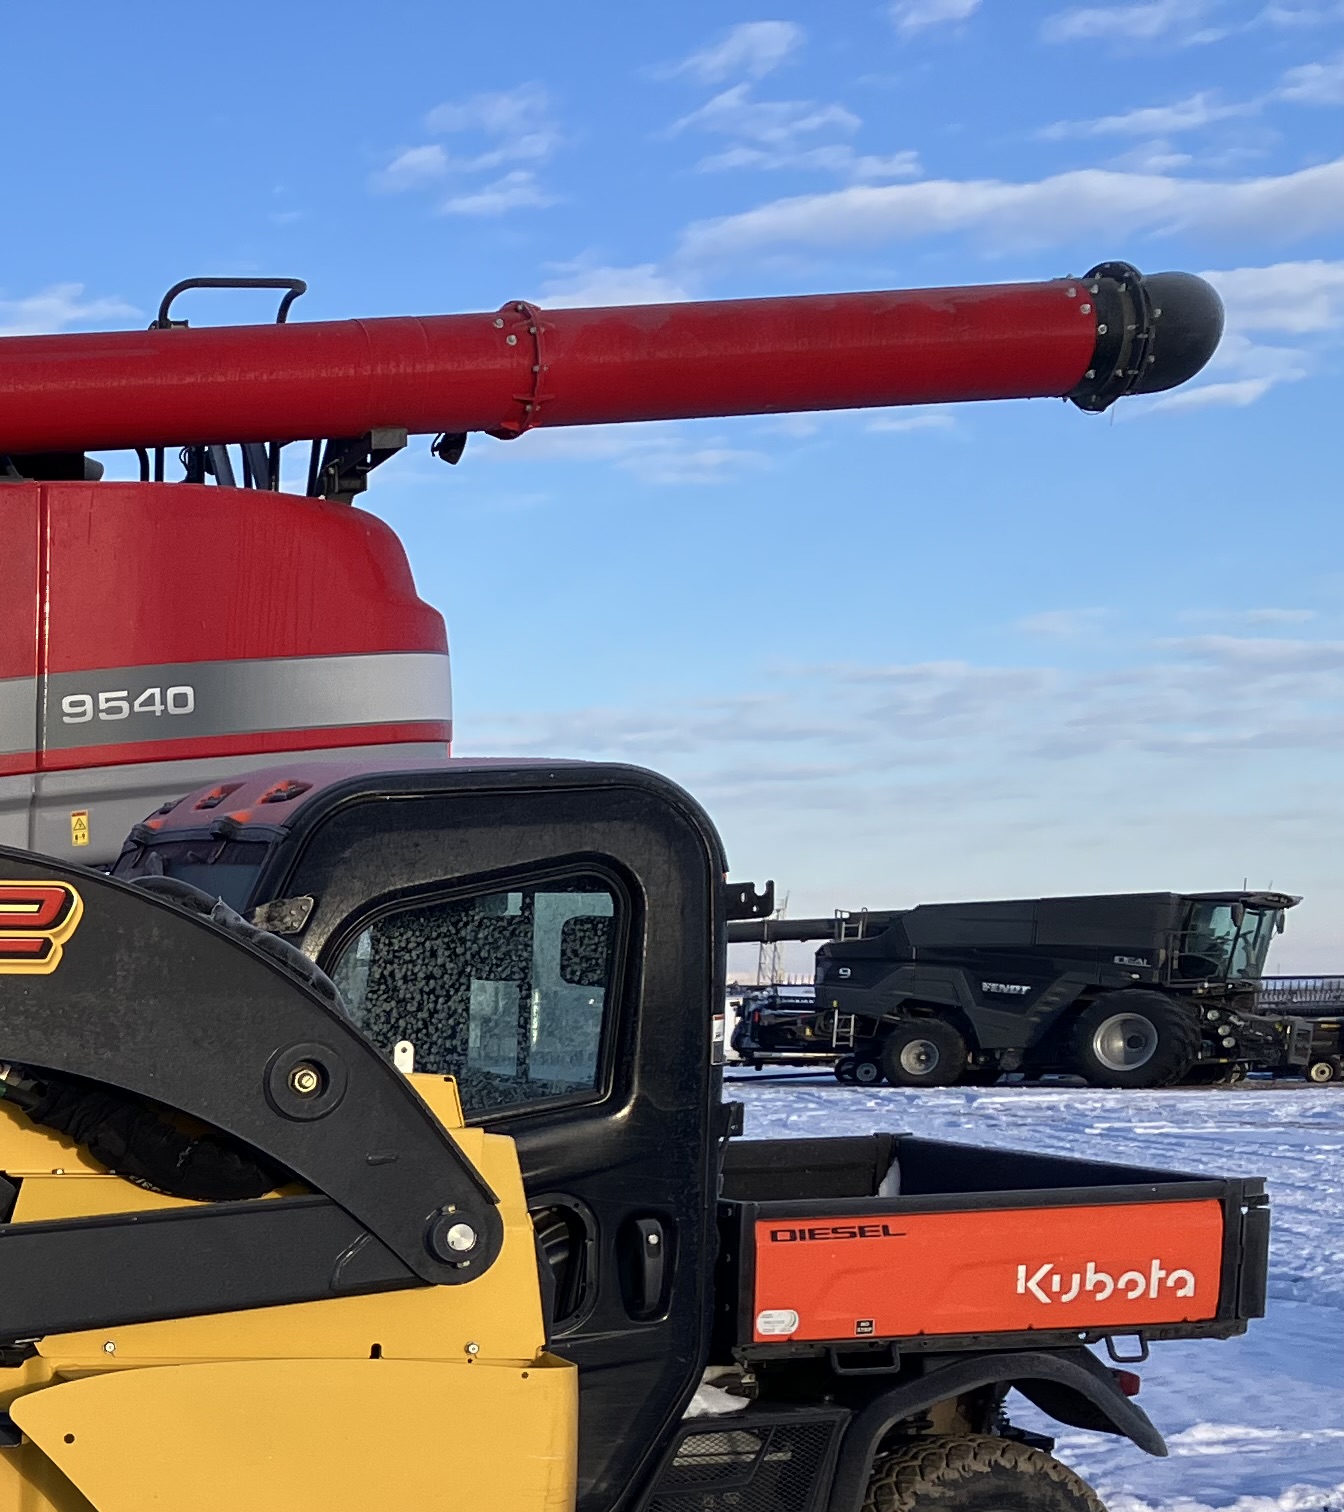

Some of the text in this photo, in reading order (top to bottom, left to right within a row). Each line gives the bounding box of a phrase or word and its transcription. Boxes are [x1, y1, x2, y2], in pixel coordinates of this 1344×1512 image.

[62, 686, 195, 724] 9540
[838, 967, 851, 978] 9
[982, 982, 1031, 995] FENDT
[770, 1224, 907, 1242] DIESEL
[1016, 1258, 1195, 1304] Kubota
